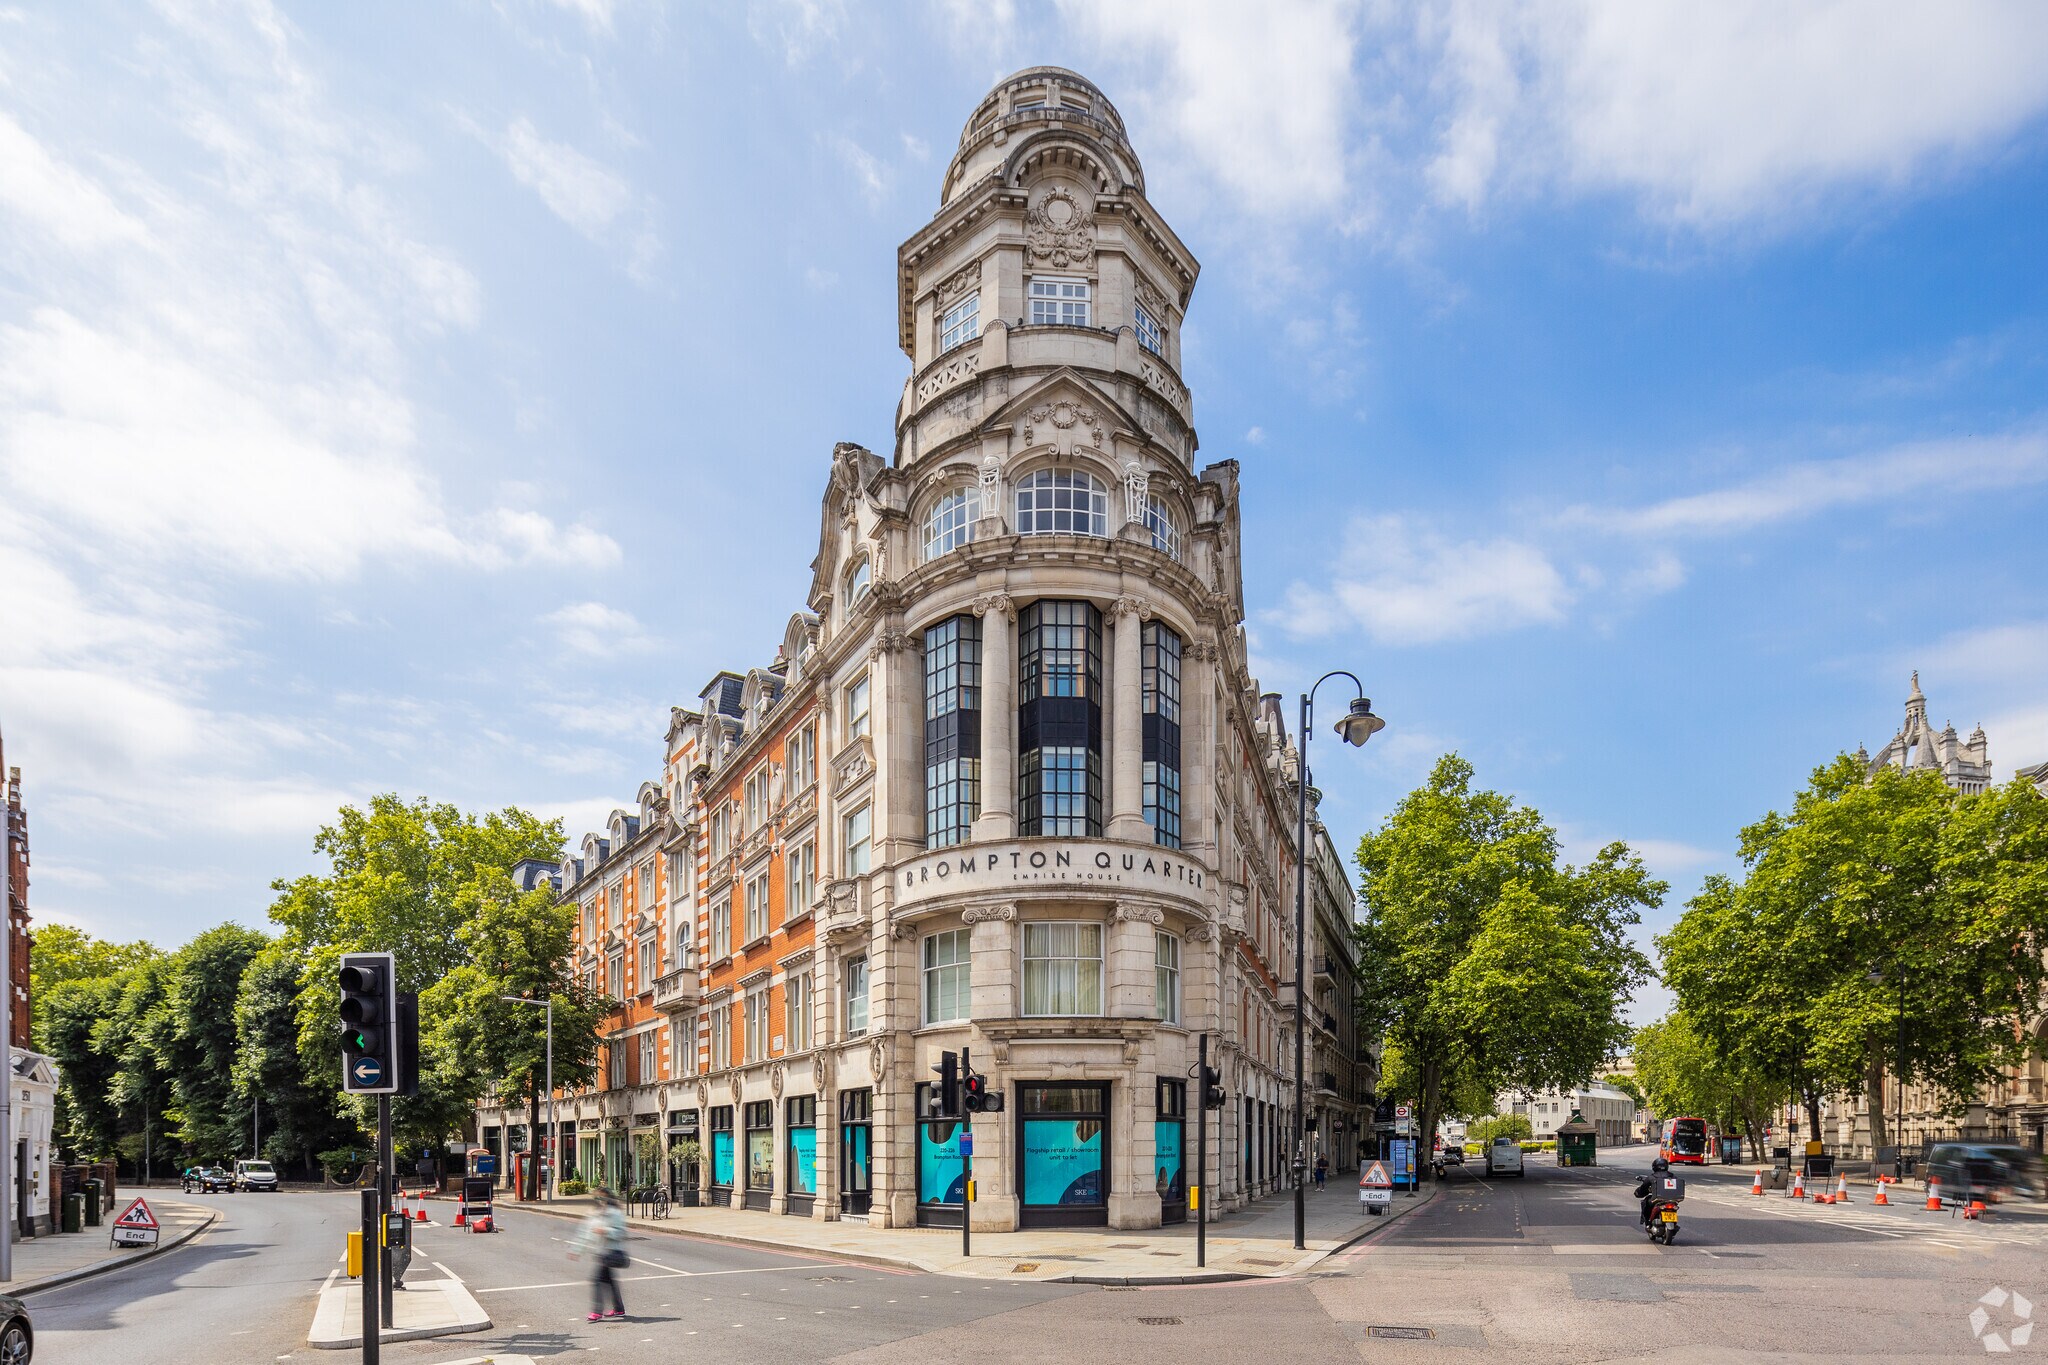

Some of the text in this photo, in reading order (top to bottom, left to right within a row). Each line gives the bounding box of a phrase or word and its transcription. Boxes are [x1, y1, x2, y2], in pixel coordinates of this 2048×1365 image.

[906, 850, 1202, 889] BROMPTON QUARTER
[1013, 872, 1121, 882] EMPIRE HOUSE
[125, 1231, 146, 1240] End
